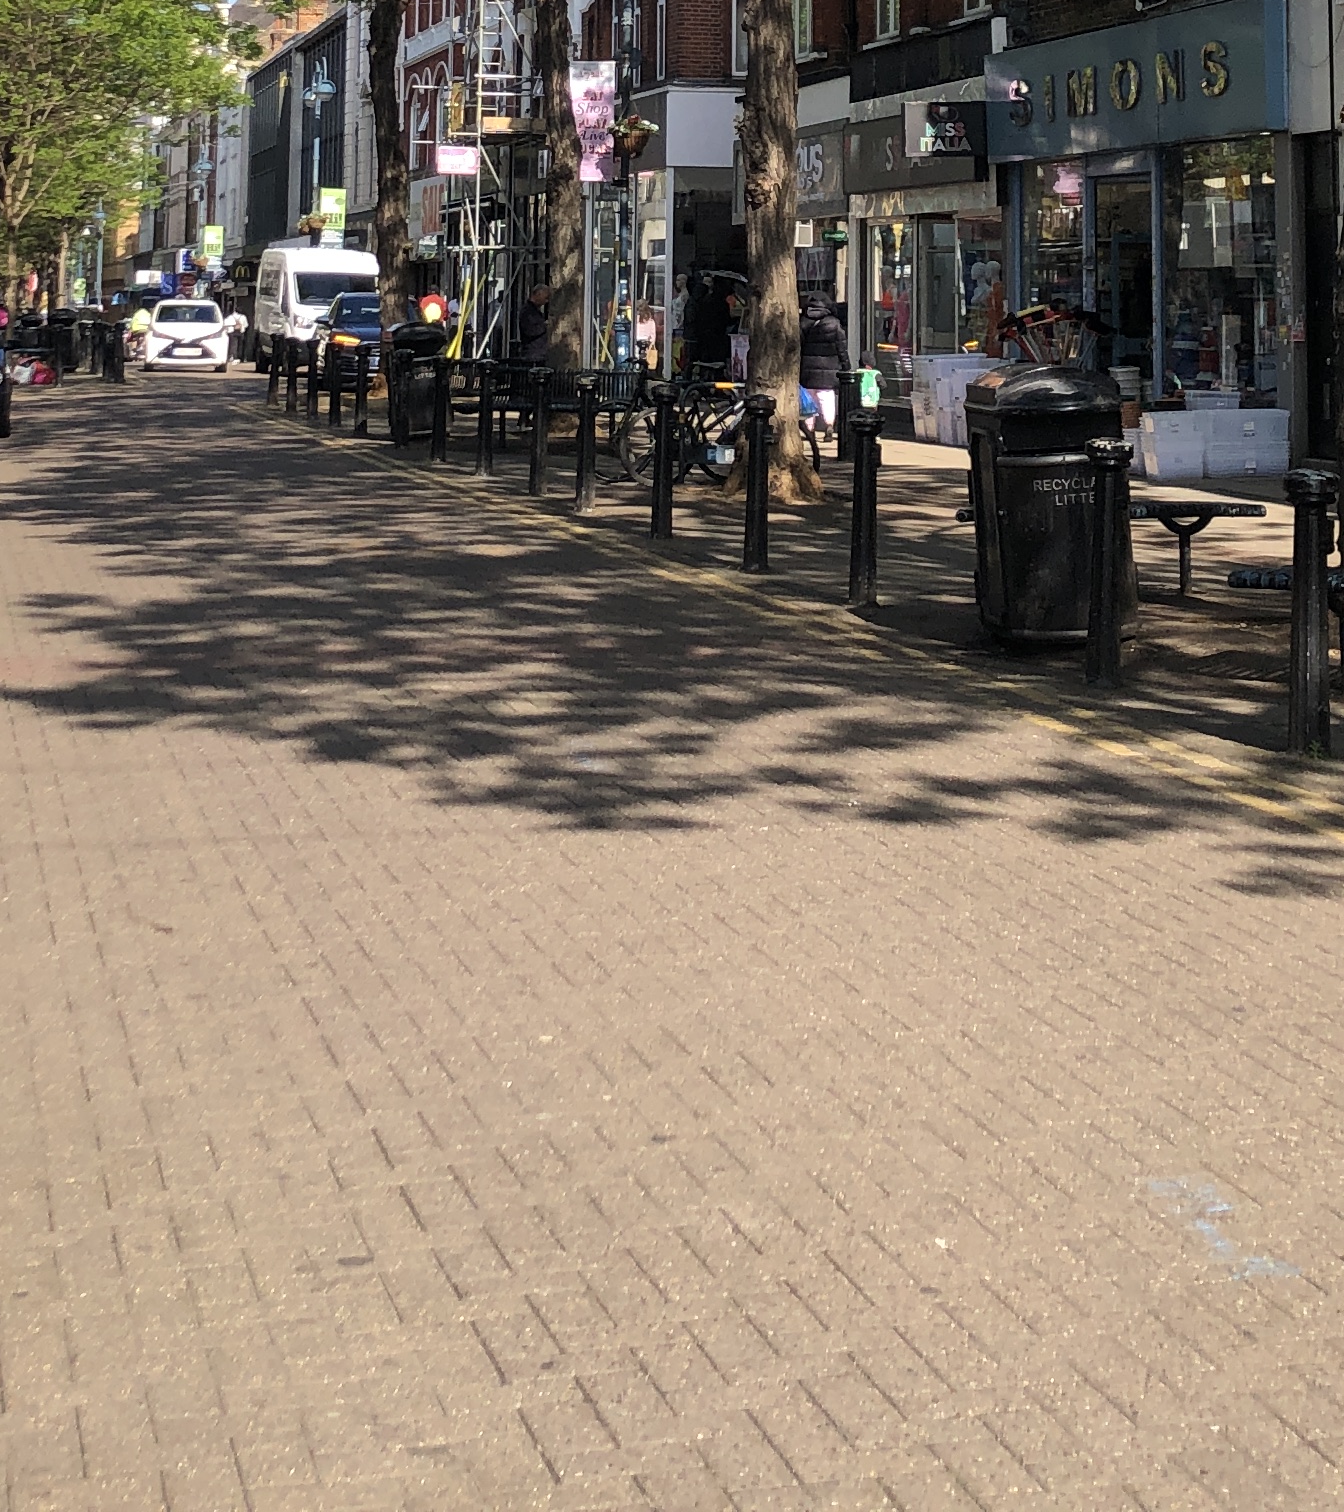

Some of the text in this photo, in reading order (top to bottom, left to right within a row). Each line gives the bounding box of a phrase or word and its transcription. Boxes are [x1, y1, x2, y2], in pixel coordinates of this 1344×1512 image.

[1010, 41, 1229, 127] SIMONS
[576, 103, 609, 117] Shop
[926, 122, 966, 137] MISS
[920, 137, 972, 152] ITALIA
[206, 243, 221, 253] Hi!
[1033, 477, 1095, 491] RECYCLA
[1055, 492, 1095, 506] LITTE
